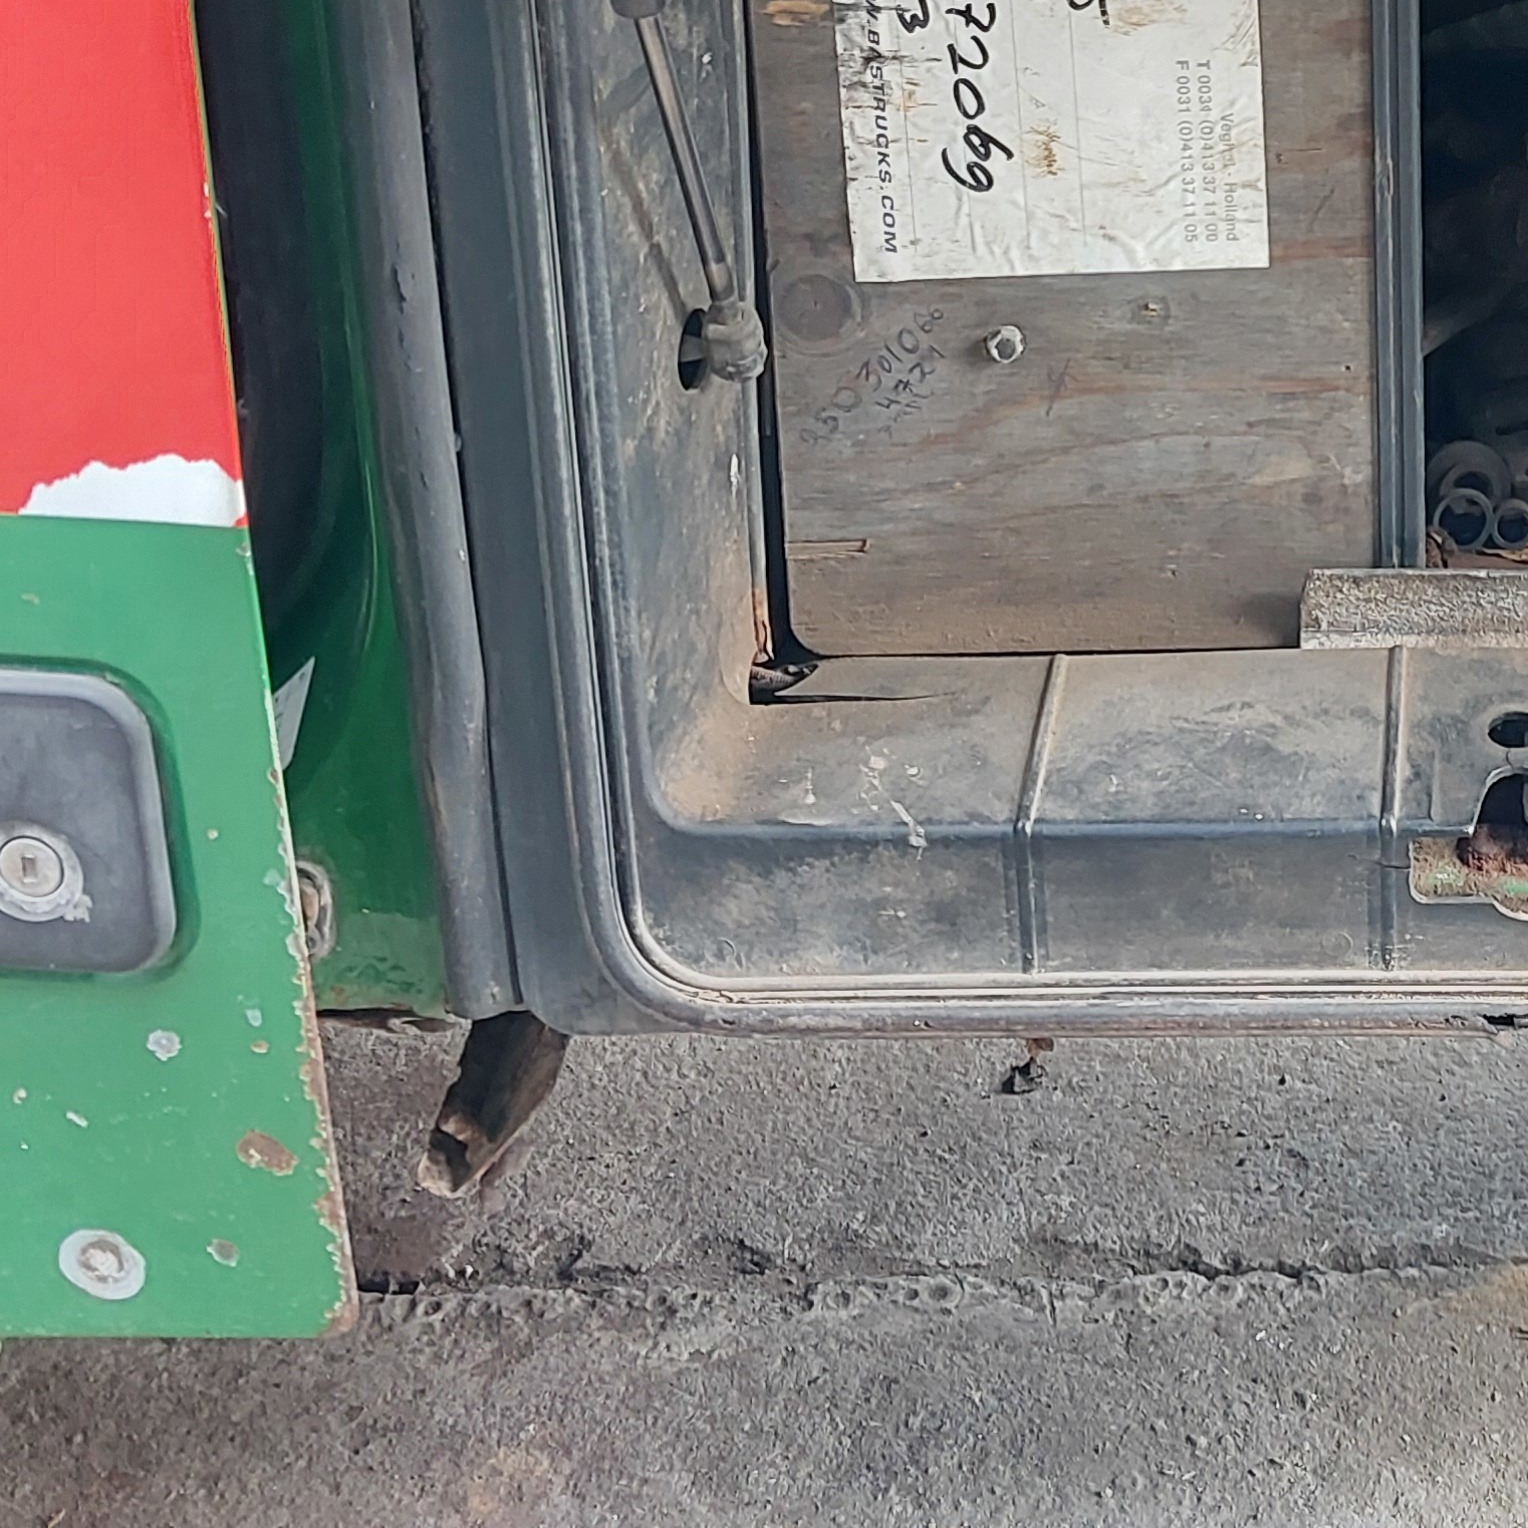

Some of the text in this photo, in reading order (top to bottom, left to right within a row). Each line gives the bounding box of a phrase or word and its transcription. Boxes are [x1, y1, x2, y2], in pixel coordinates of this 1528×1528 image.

[1196, 59, 1211, 70] T
[1175, 59, 1198, 243] F 0031 (0)413 37 11 05
[1198, 120, 1216, 172] (0)413
[1202, 176, 1217, 195] 37
[1204, 201, 1217, 217] 11
[1223, 182, 1240, 242] Holland
[1204, 223, 1219, 243] 00
